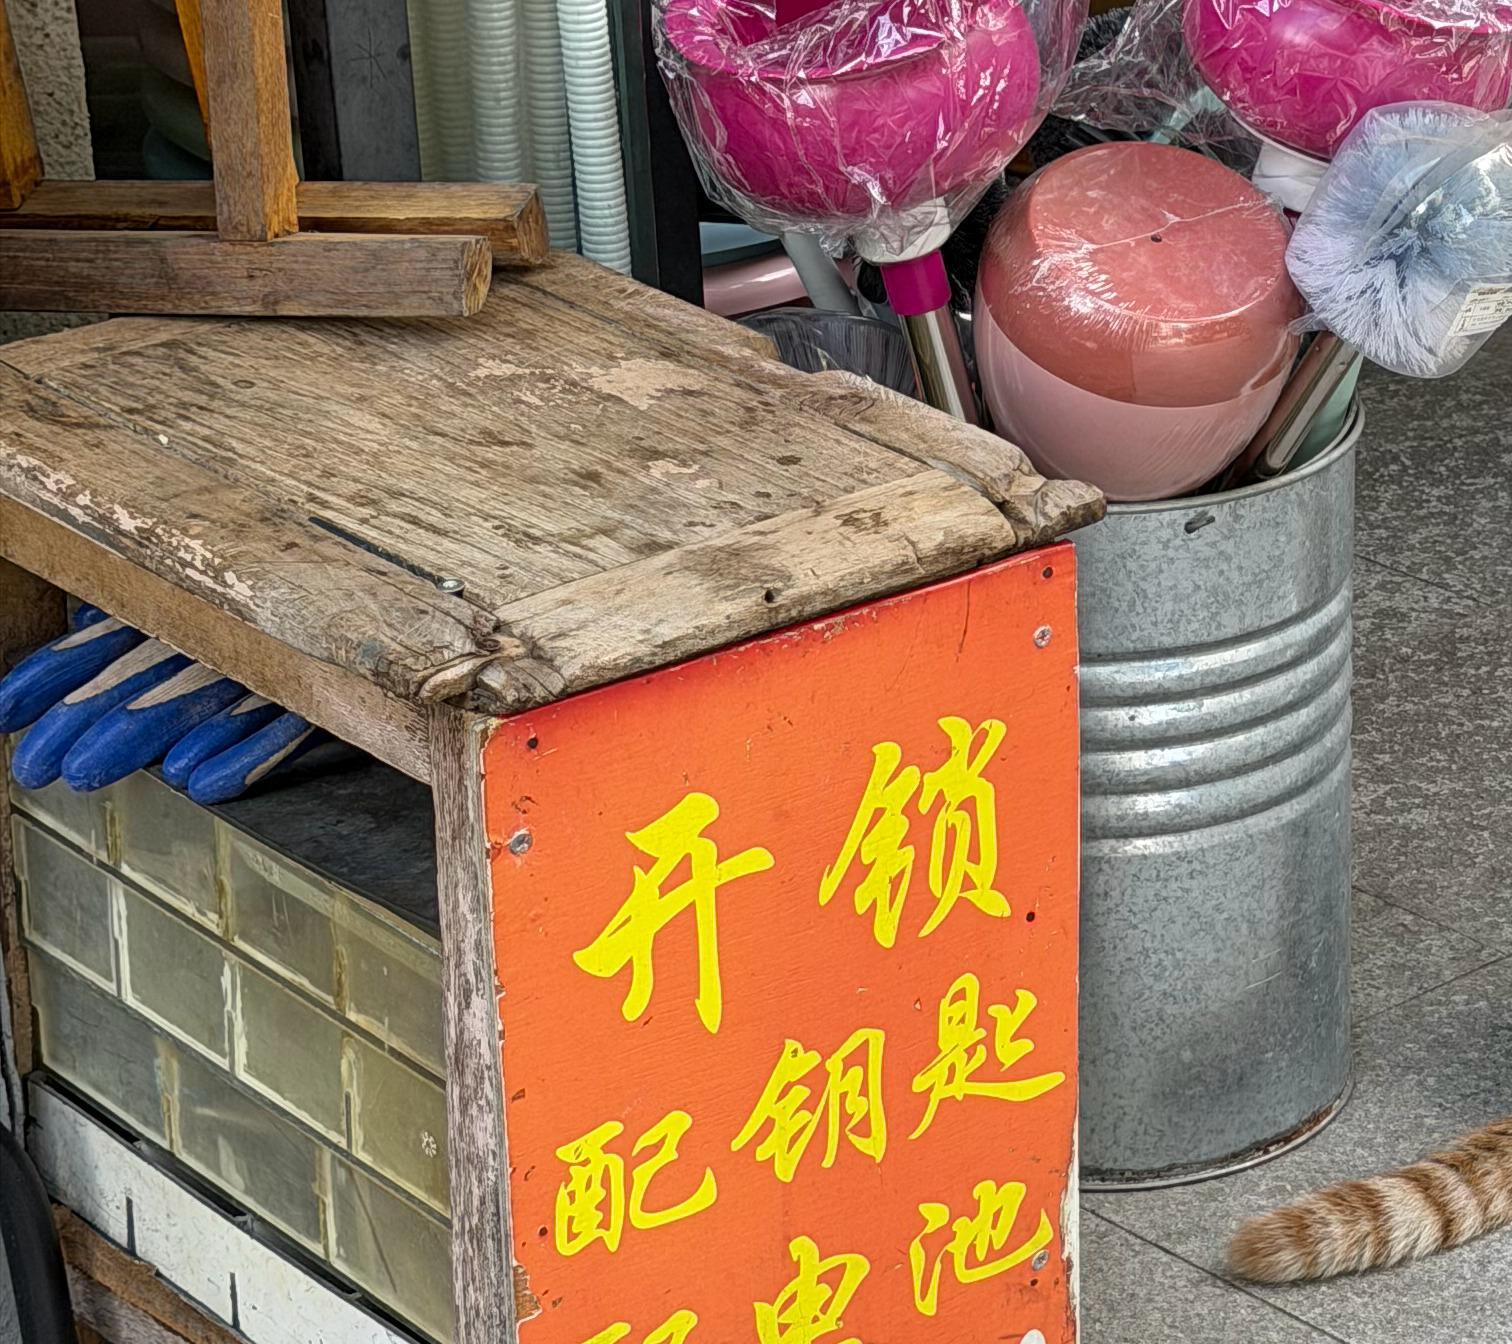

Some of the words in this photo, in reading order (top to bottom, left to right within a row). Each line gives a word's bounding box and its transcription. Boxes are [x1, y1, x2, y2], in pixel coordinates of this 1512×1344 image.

[573, 716, 1012, 1034] 开锁
[554, 972, 1067, 1257] 配钥匙
